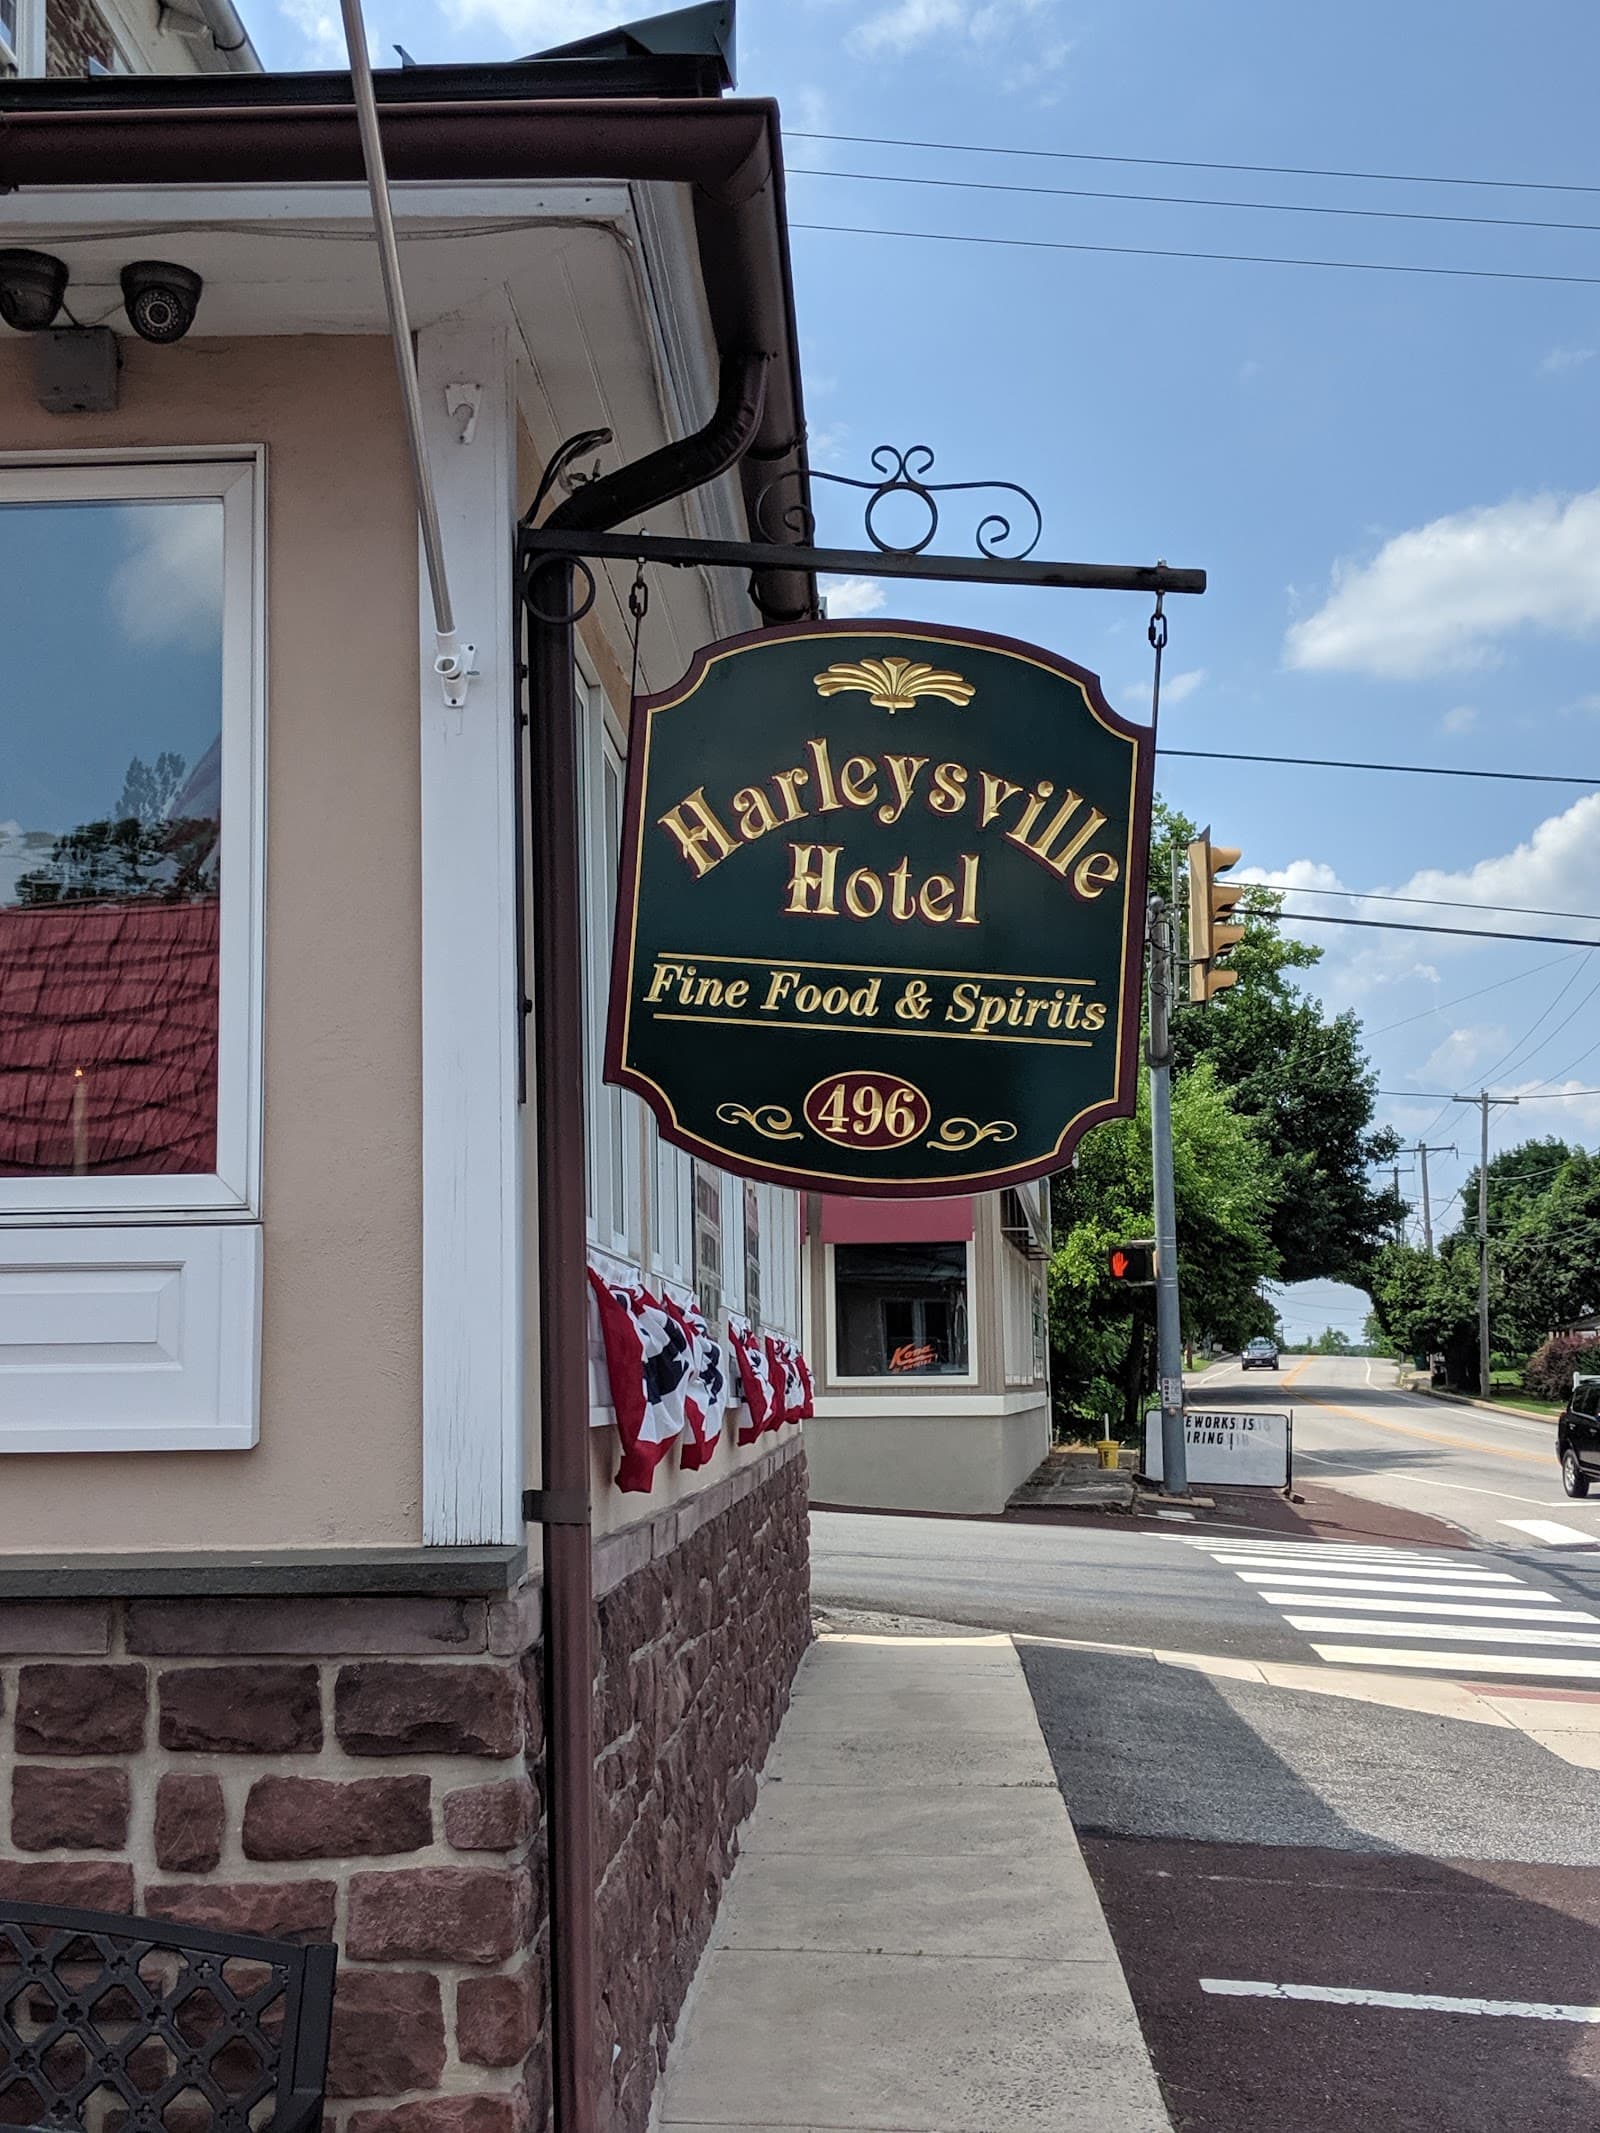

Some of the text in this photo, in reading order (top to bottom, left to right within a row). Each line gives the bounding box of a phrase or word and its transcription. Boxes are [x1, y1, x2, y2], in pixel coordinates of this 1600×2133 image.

[658, 737, 1119, 898] Harleysville
[784, 843, 981, 924] Hotel
[643, 963, 1107, 1033] Fine Food & Spirits
[818, 1084, 915, 1138] 496
[1185, 1415, 1255, 1431] EWORKS IS
[1186, 1431, 1224, 1445] IRING
